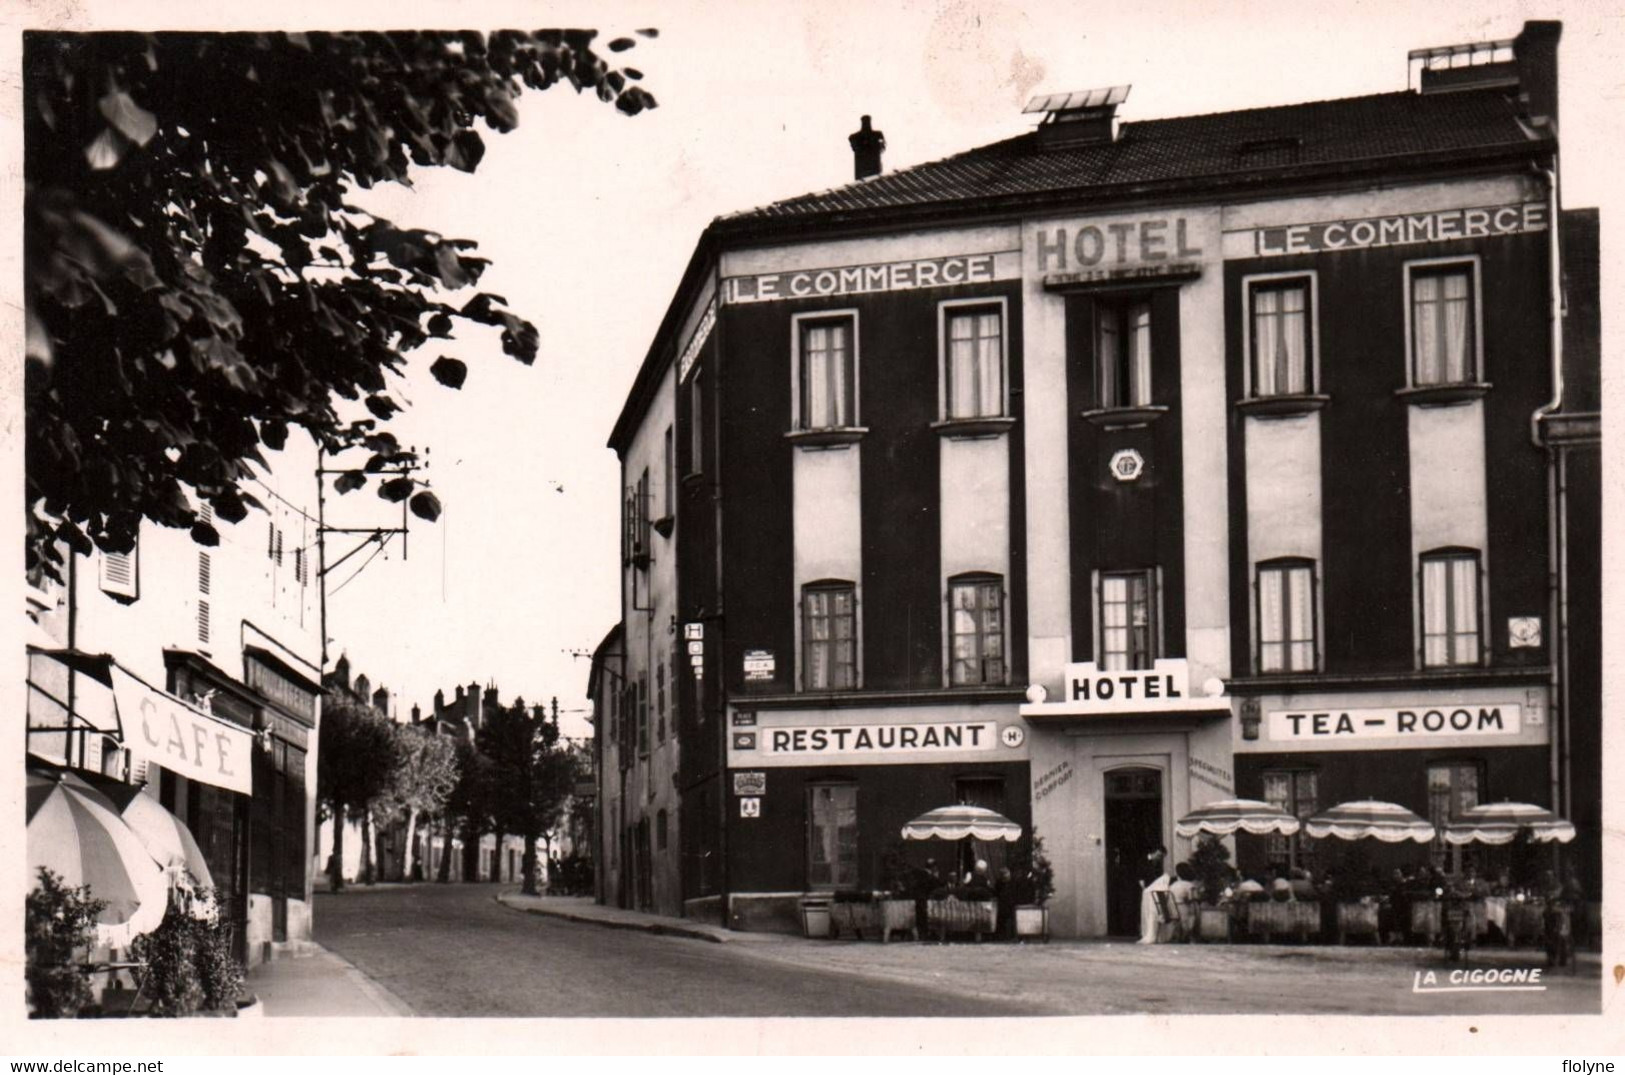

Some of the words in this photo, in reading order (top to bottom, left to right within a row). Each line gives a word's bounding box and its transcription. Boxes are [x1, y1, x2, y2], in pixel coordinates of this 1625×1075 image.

[1037, 218, 1202, 271] HOTEL
[1259, 227, 1311, 256] LE
[1323, 204, 1548, 248] COMMERCE
[733, 275, 780, 302] LE
[790, 256, 990, 295] COMMERCE
[1072, 675, 1182, 701] HOTEL
[773, 726, 985, 751] RESTAURANT
